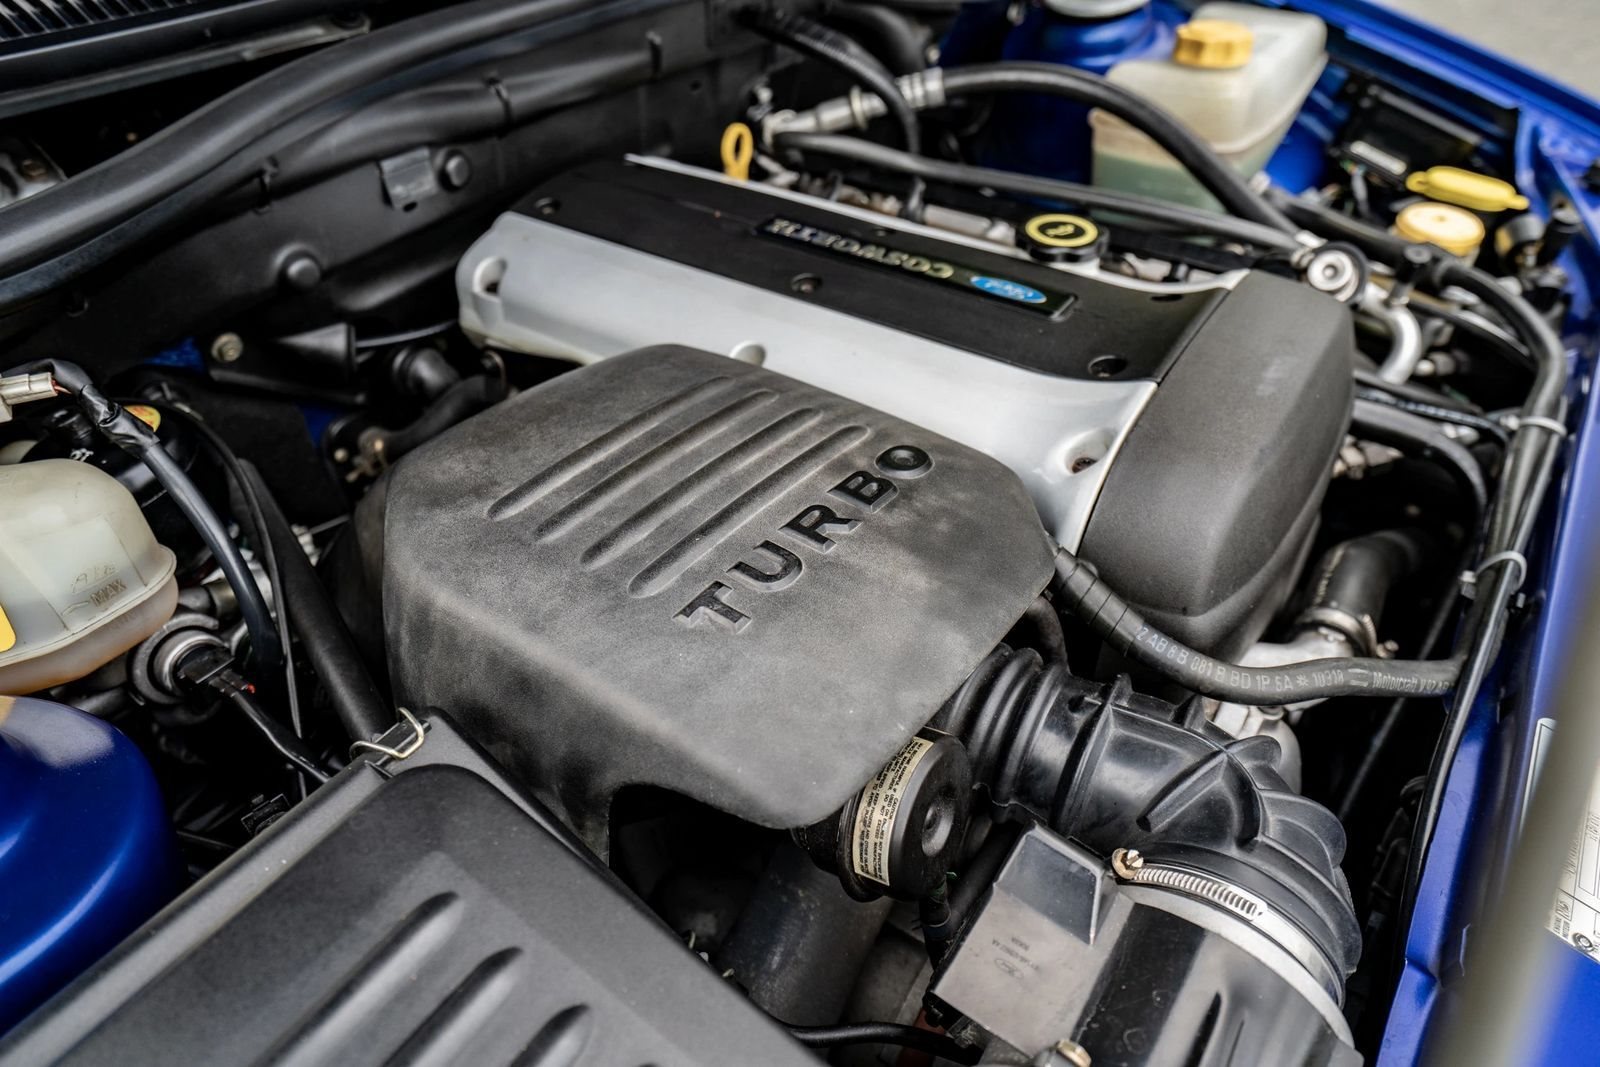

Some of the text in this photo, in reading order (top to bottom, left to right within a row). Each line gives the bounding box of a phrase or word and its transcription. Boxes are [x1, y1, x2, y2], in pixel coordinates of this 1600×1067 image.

[768, 218, 954, 279] COSWORTH
[672, 445, 935, 634] TURBO
[90, 579, 127, 607] MAX
[889, 797, 899, 820] CAUTION
[880, 818, 888, 840] ENNES
